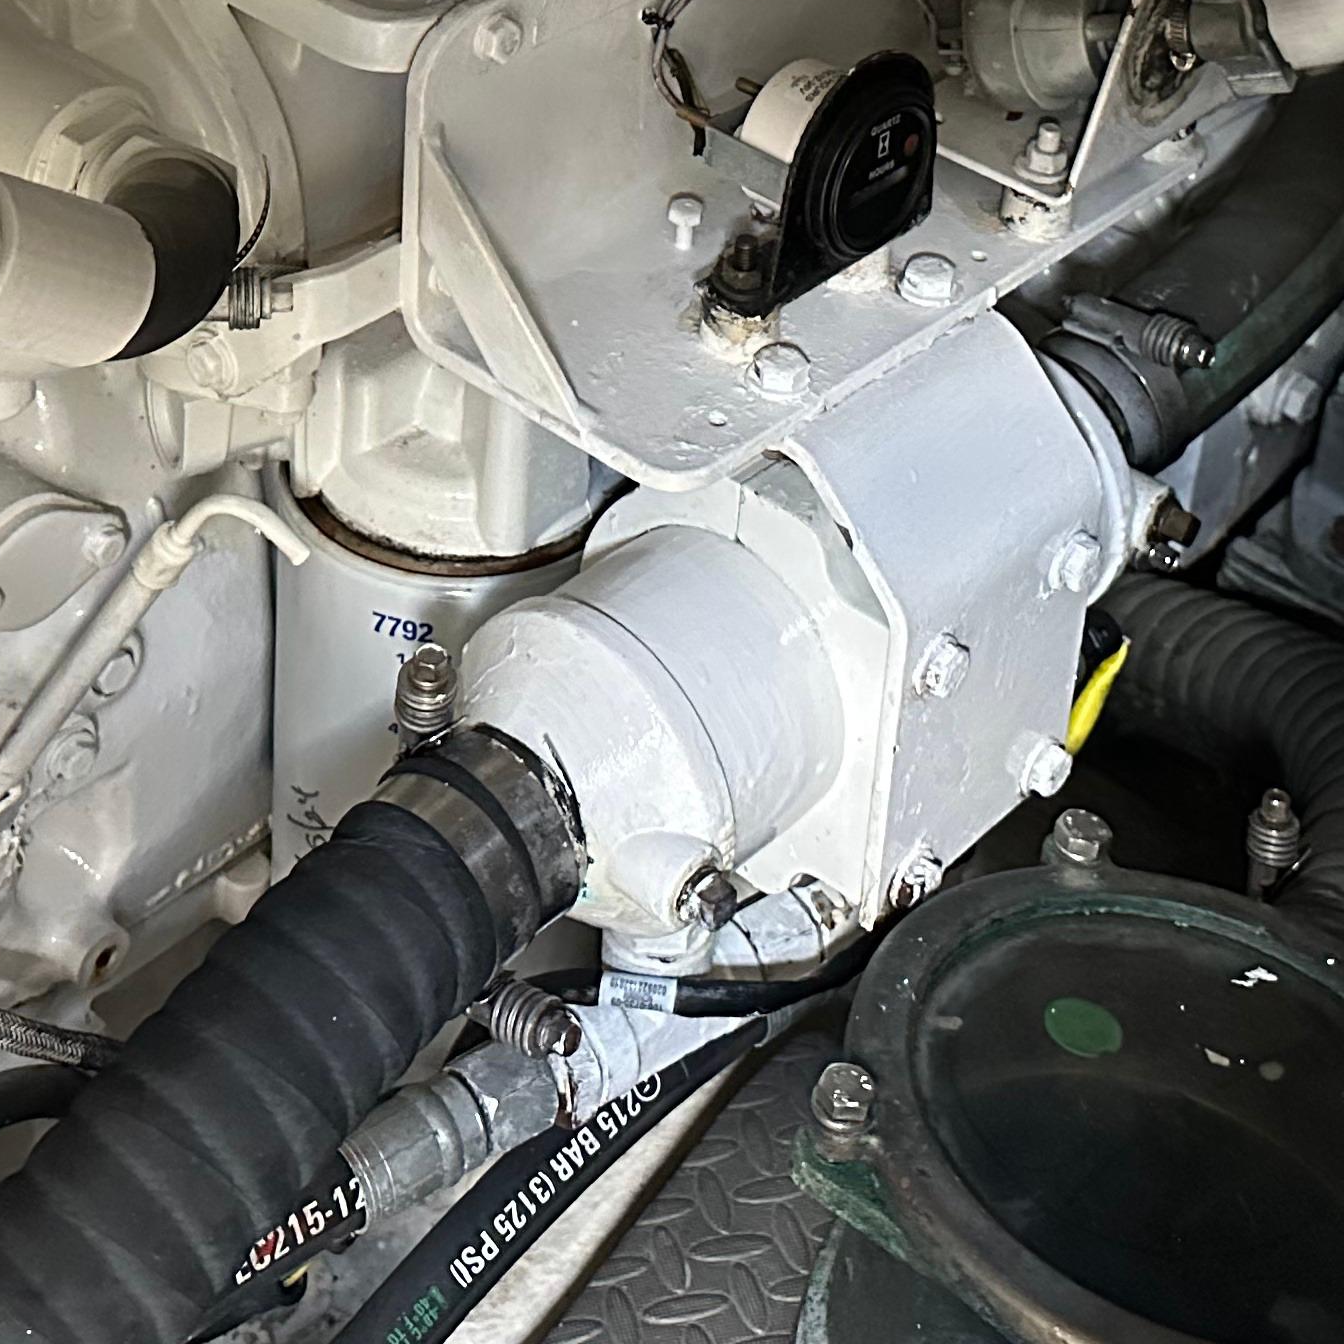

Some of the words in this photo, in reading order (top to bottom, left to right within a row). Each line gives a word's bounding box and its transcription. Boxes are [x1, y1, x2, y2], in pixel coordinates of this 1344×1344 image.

[372, 610, 435, 644] 7792
[285, 785, 336, 861] 5/24
[596, 1090, 641, 1139] 215
[549, 1125, 601, 1182] BAR
[493, 1170, 556, 1243] (3125
[449, 1230, 500, 1289] PSI)
